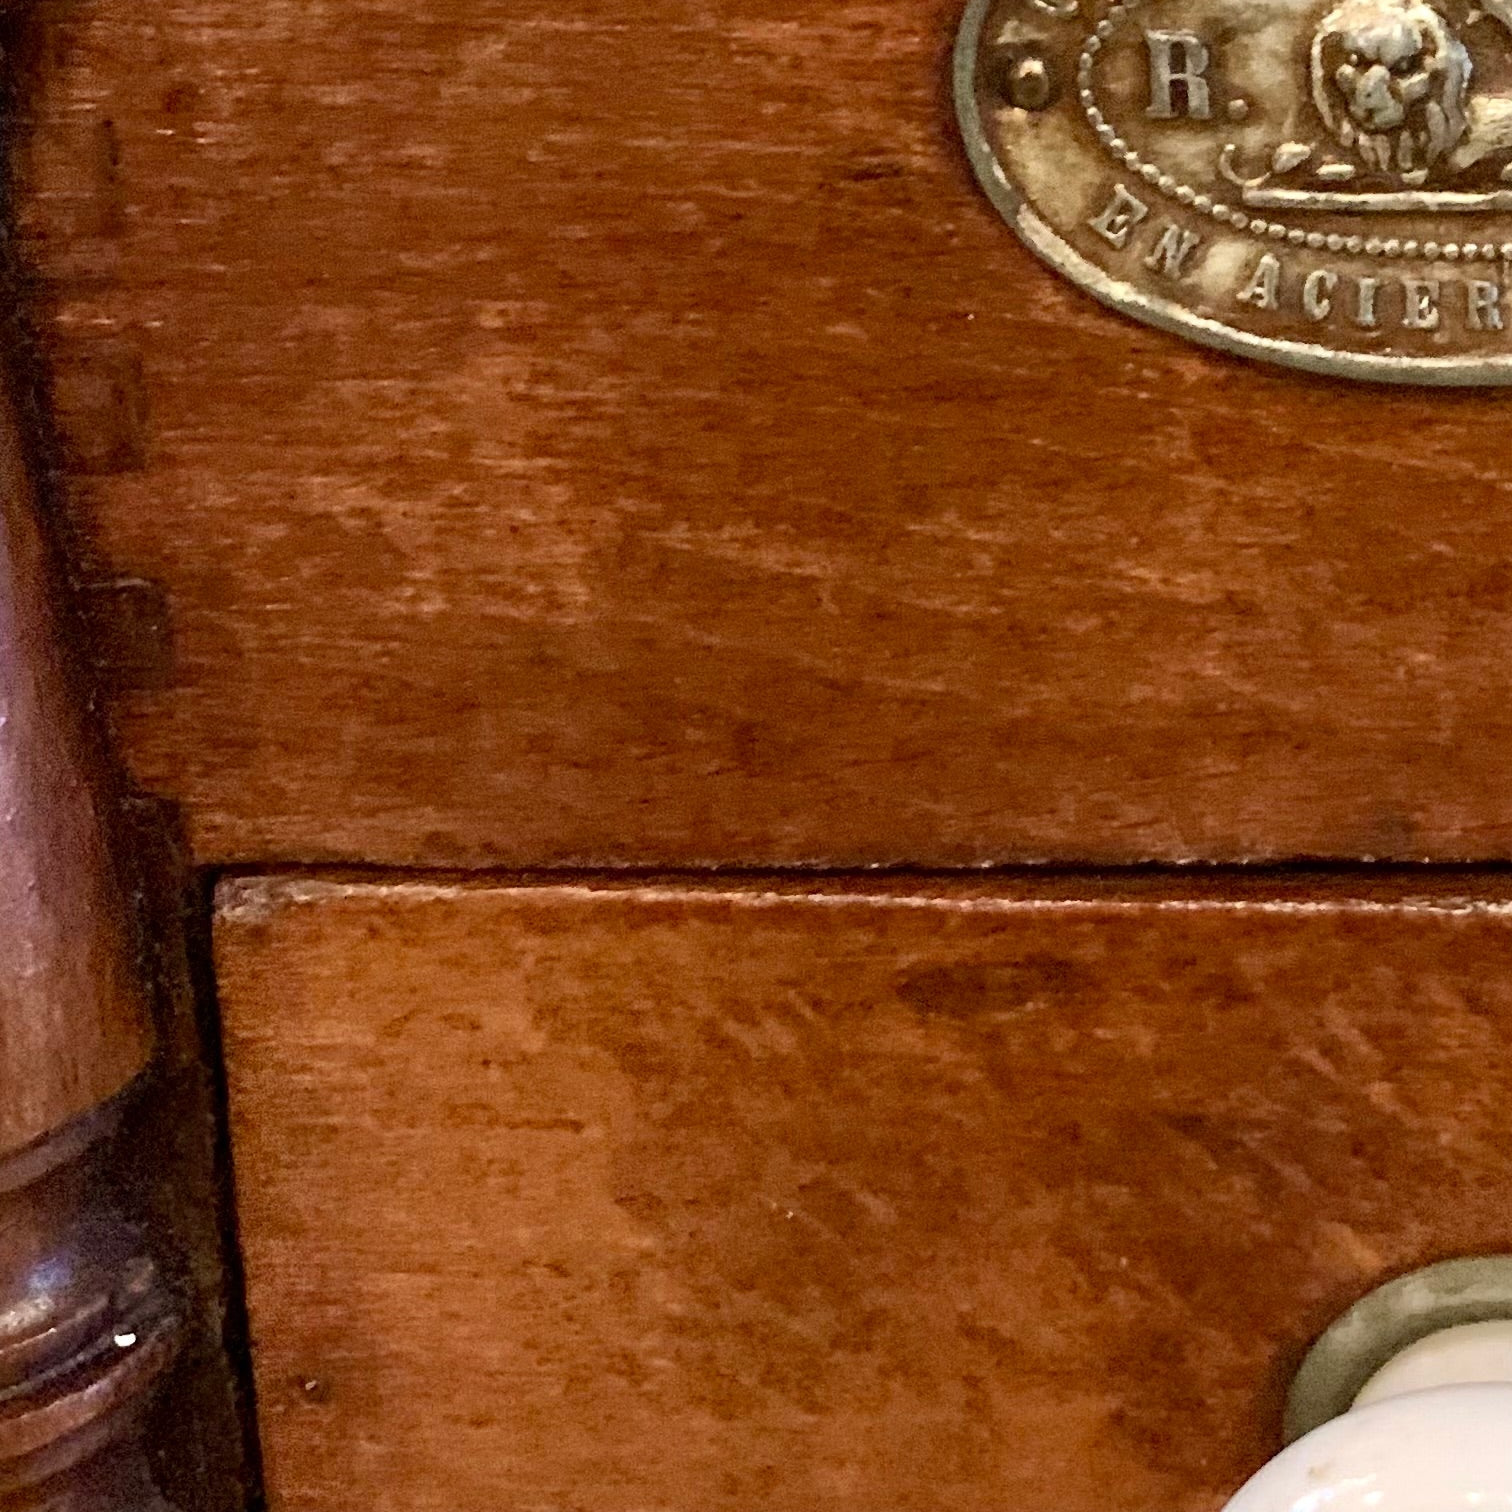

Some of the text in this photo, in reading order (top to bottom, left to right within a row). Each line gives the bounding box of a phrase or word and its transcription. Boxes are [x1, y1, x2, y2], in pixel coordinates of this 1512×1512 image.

[1146, 28, 1250, 121] R.
[1087, 183, 1198, 279] EN
[1236, 252, 1503, 331] ACIER
